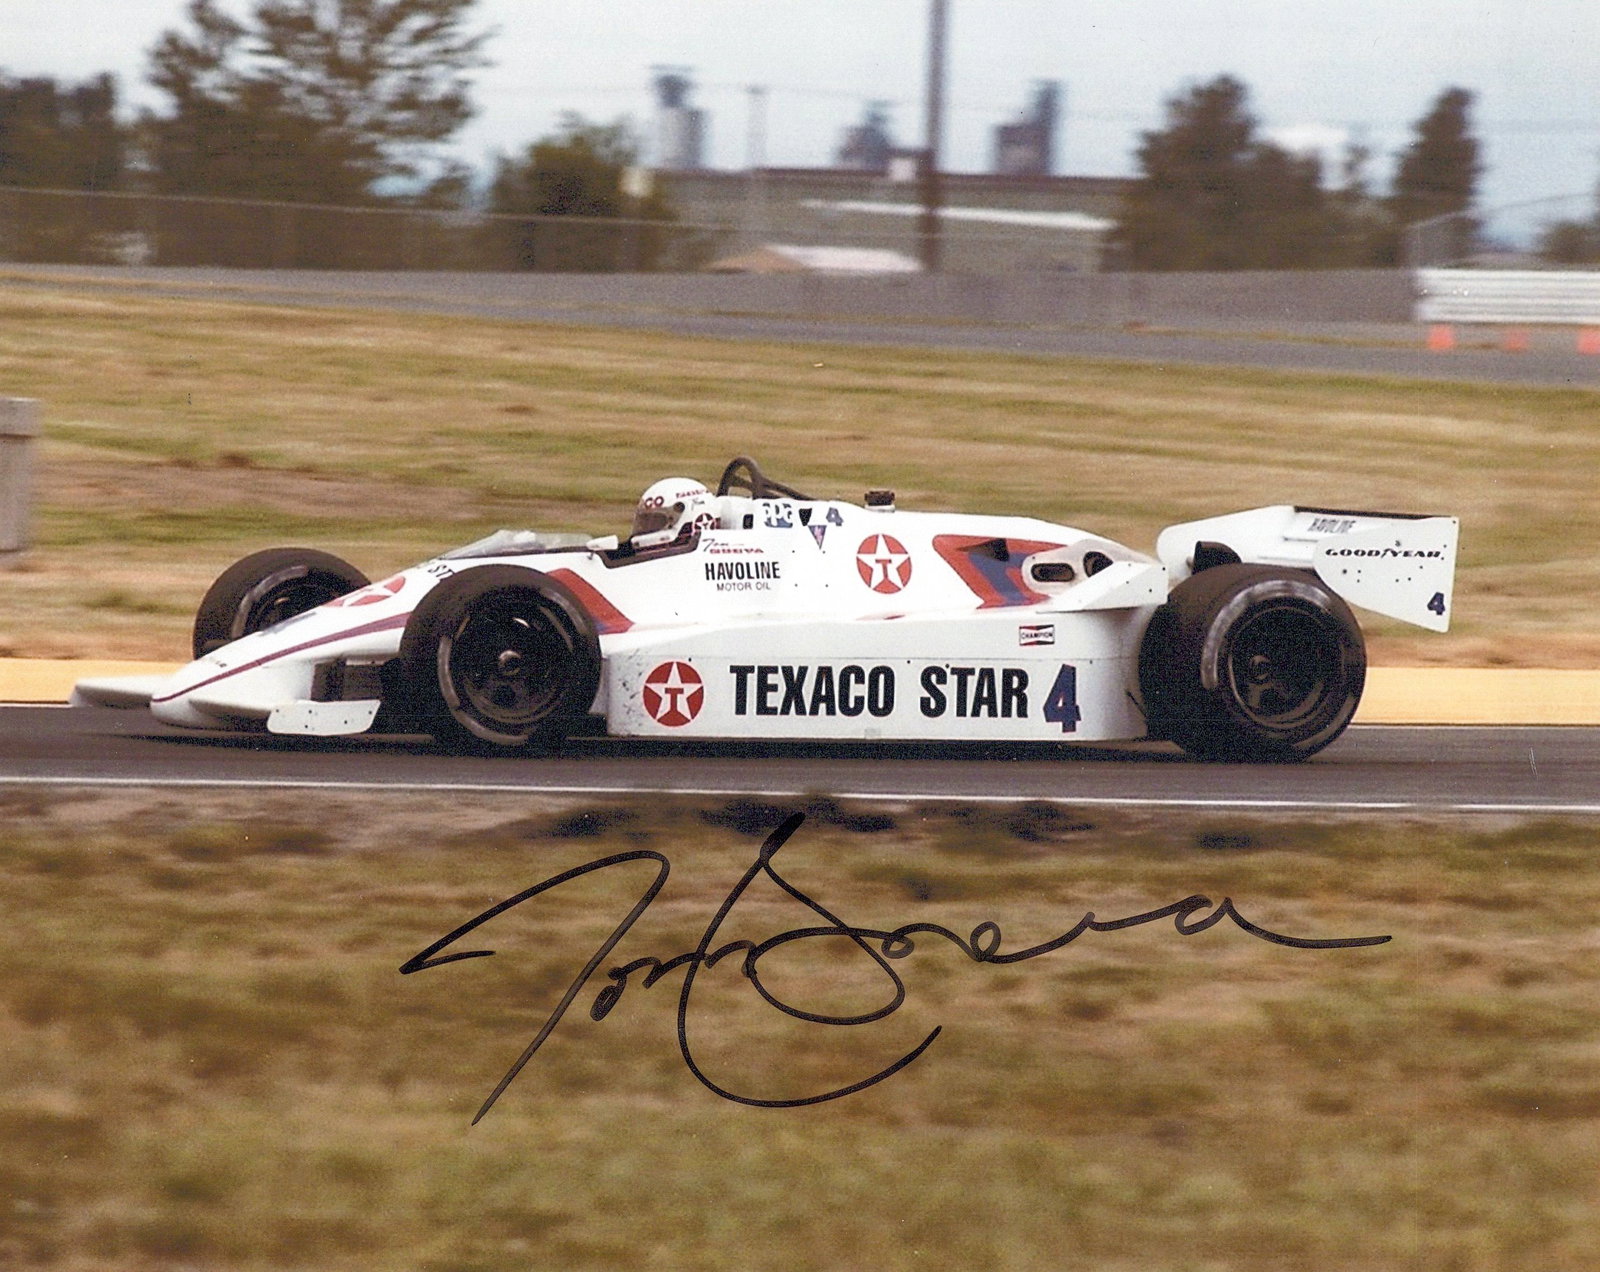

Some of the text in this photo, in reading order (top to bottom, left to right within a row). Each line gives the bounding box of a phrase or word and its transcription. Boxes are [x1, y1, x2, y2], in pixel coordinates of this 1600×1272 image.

[826, 507, 844, 526] 4
[1325, 548, 1441, 558] GOODYEAR
[705, 562, 781, 580] HAVOLINE
[717, 581, 771, 591] MOTOR OIL
[1427, 592, 1446, 616] 4
[1021, 631, 1053, 640] CHAMPION
[730, 664, 1082, 733] TEXACO STAR 4
